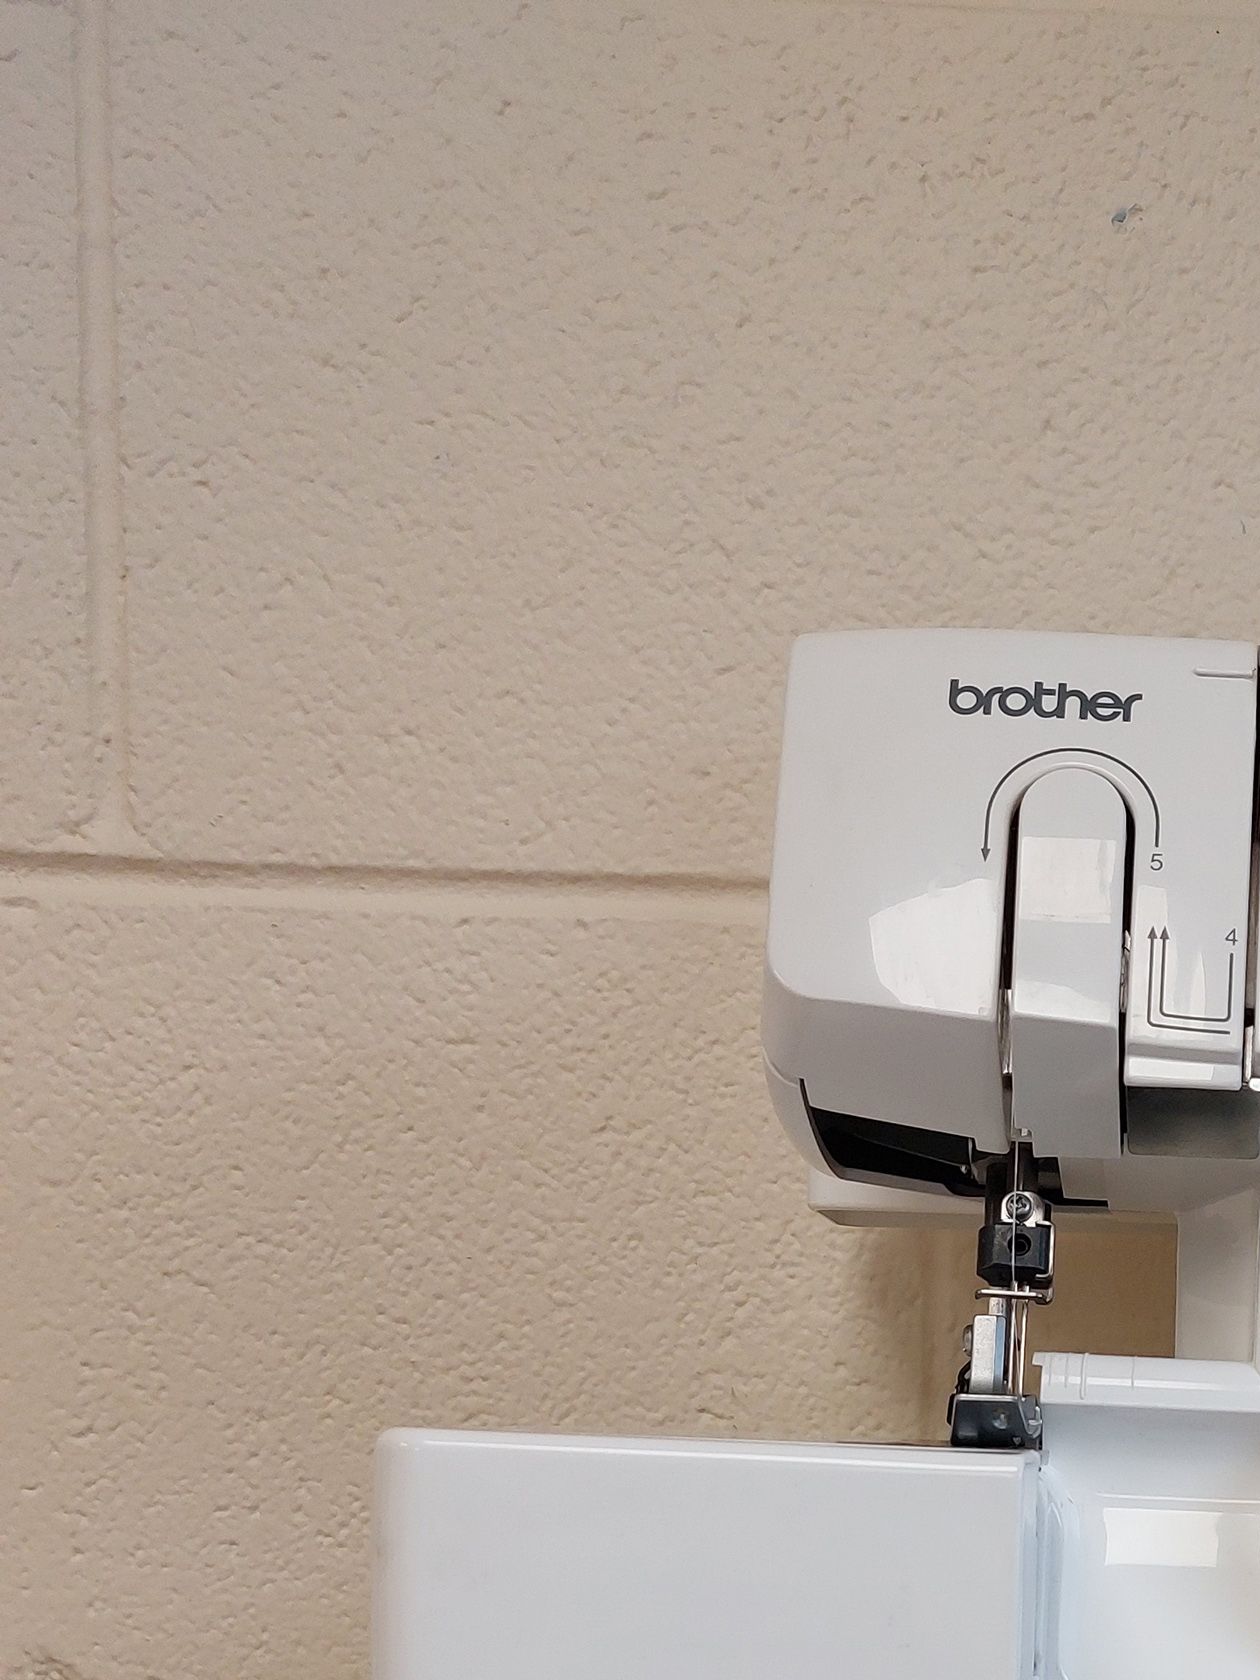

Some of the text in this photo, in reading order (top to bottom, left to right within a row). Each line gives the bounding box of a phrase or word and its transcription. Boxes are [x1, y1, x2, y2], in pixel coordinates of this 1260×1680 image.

[948, 678, 1143, 722] brother
[1149, 853, 1163, 872] 5
[1224, 929, 1239, 947] 4
